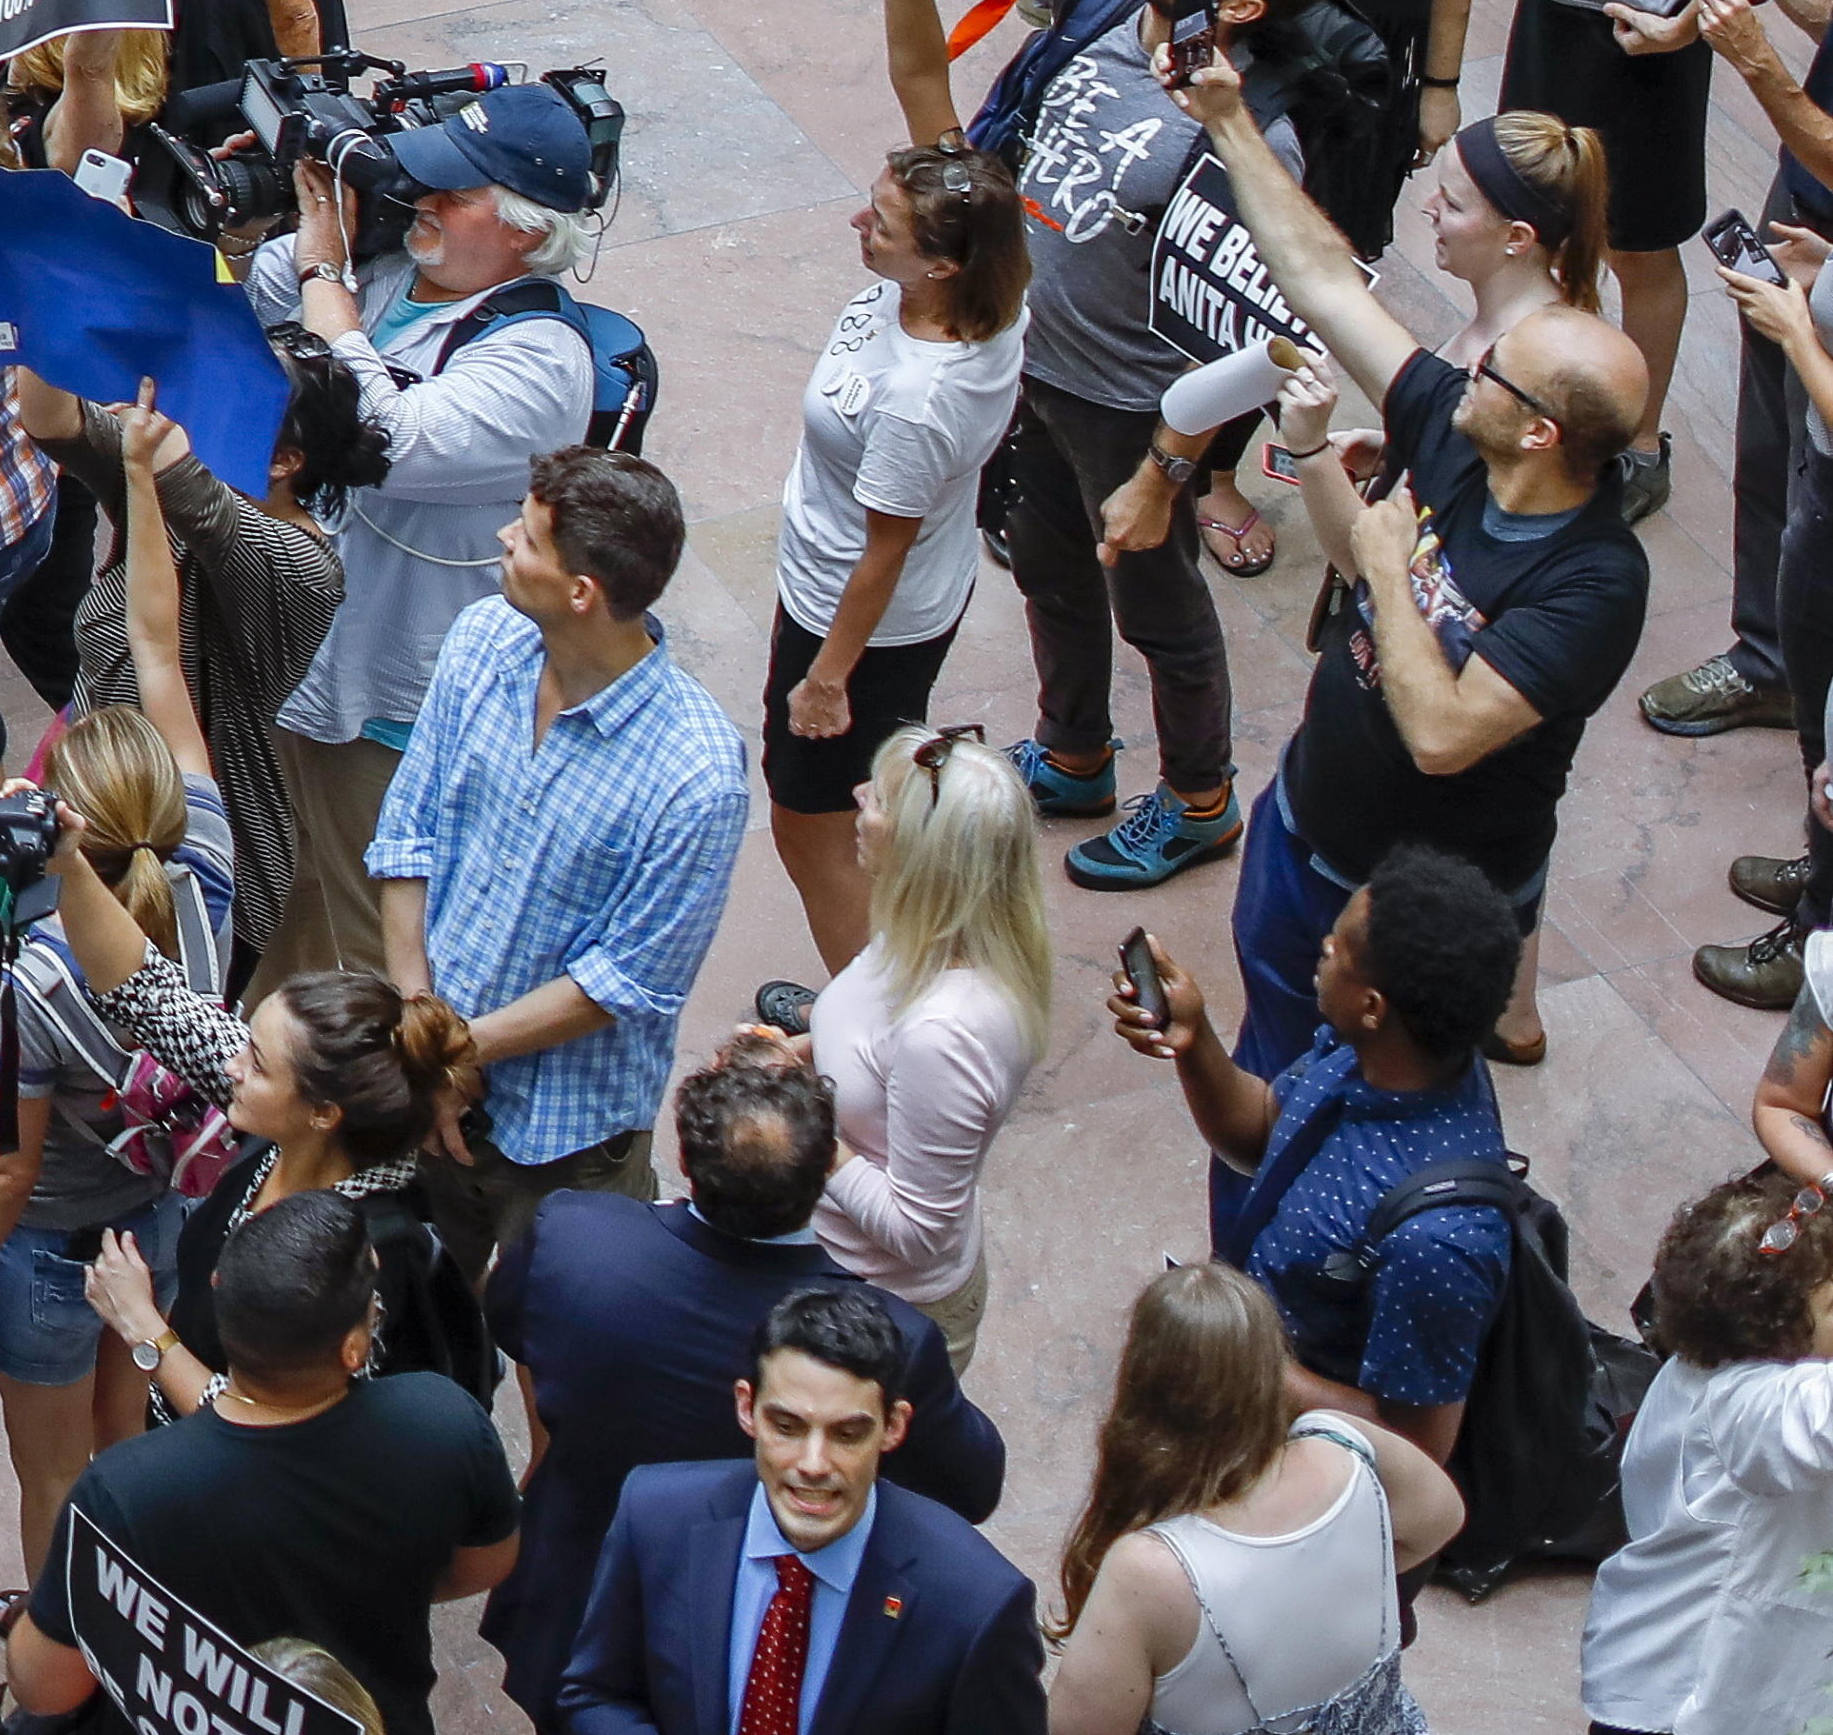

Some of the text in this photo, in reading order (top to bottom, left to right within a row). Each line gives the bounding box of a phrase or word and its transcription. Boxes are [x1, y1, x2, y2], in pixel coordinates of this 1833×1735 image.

[1166, 188, 1214, 258] WE
[1158, 255, 1236, 352] ANITA
[96, 1543, 306, 1734] WE WILL
